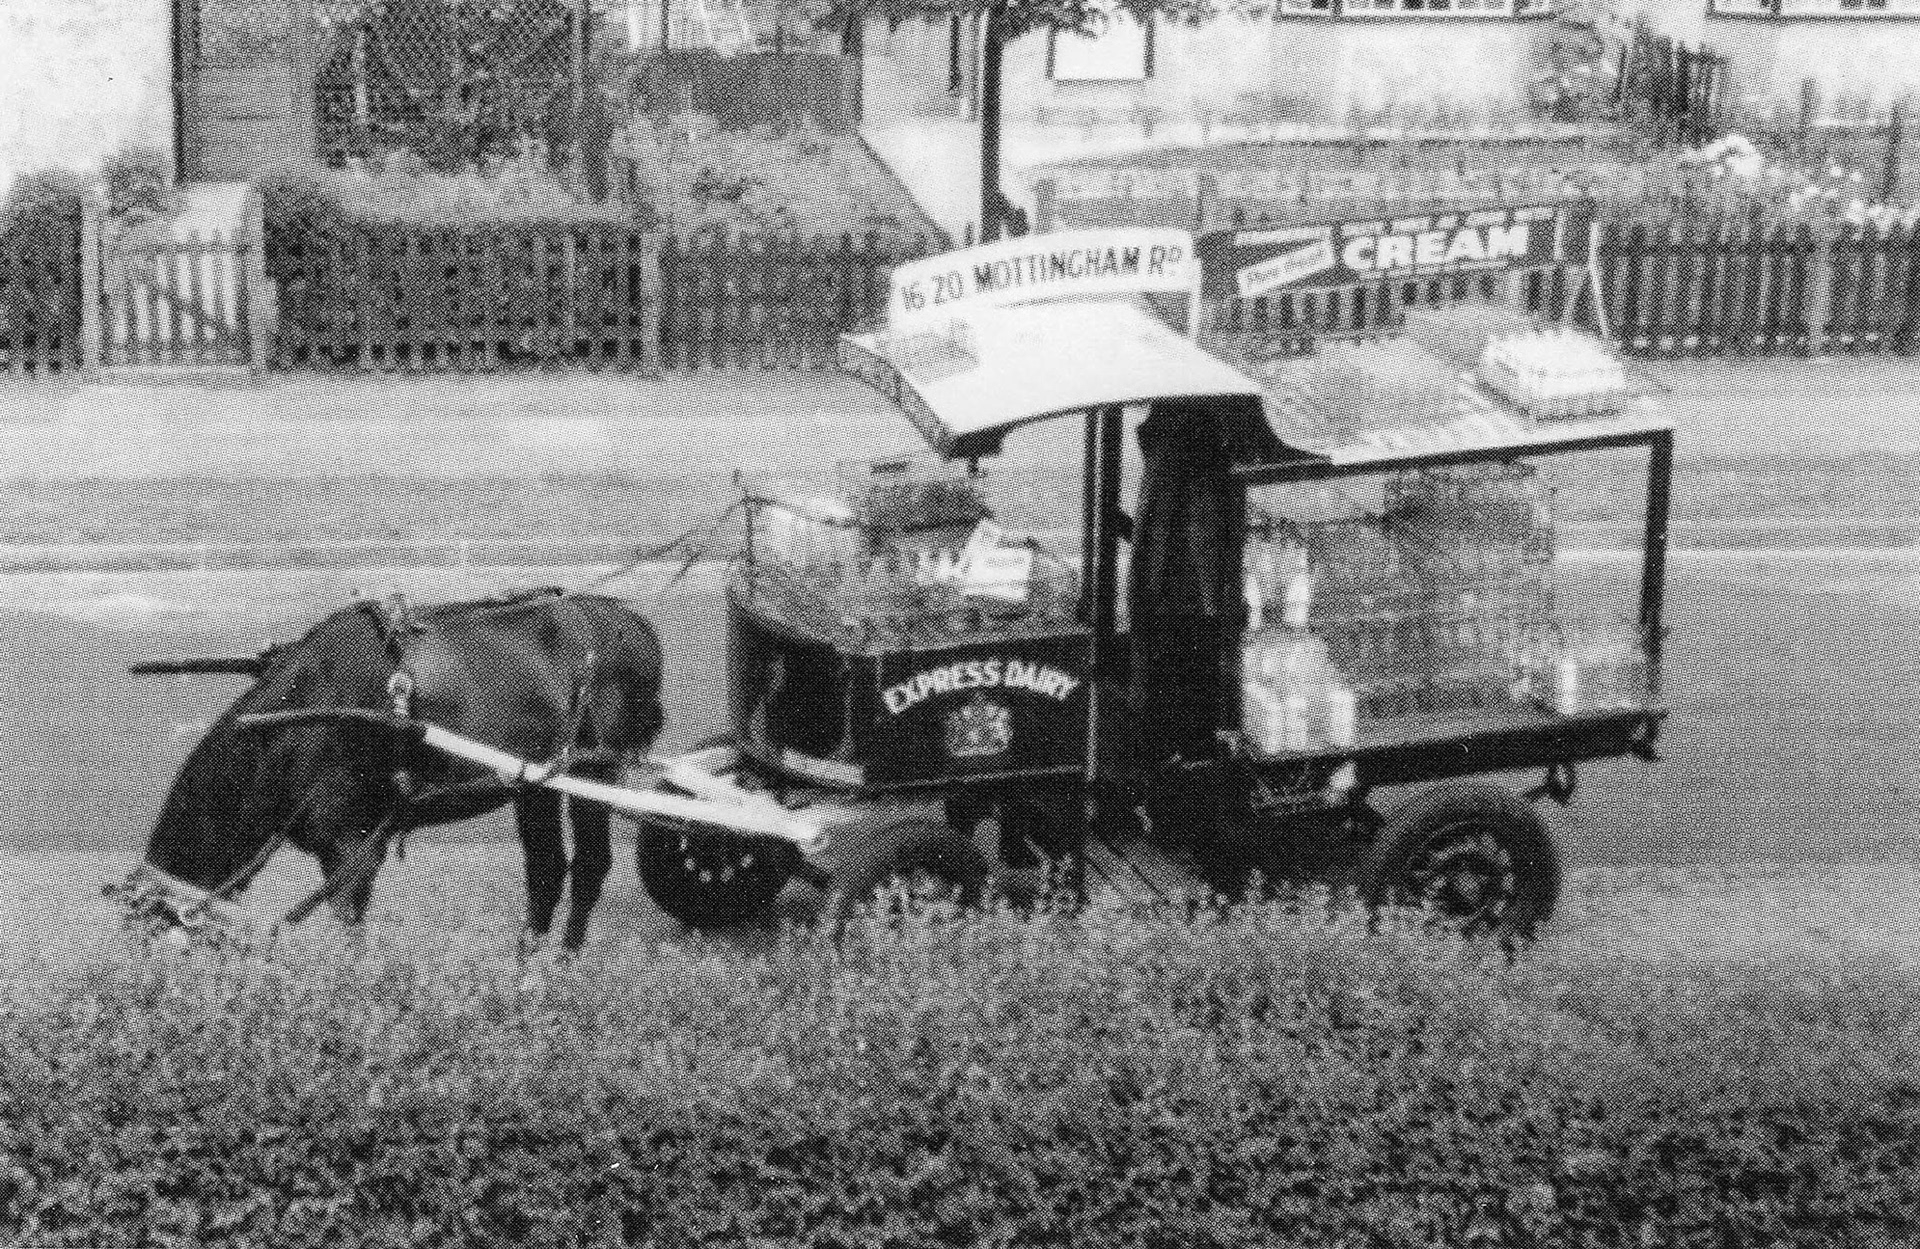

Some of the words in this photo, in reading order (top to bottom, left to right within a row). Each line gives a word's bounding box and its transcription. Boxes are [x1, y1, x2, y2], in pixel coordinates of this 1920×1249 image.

[974, 247, 1140, 293] MOTTINGHAM
[1342, 224, 1529, 270] CREAM
[884, 659, 1002, 714] EXPRESS
[1005, 660, 1079, 701] DAIRY
